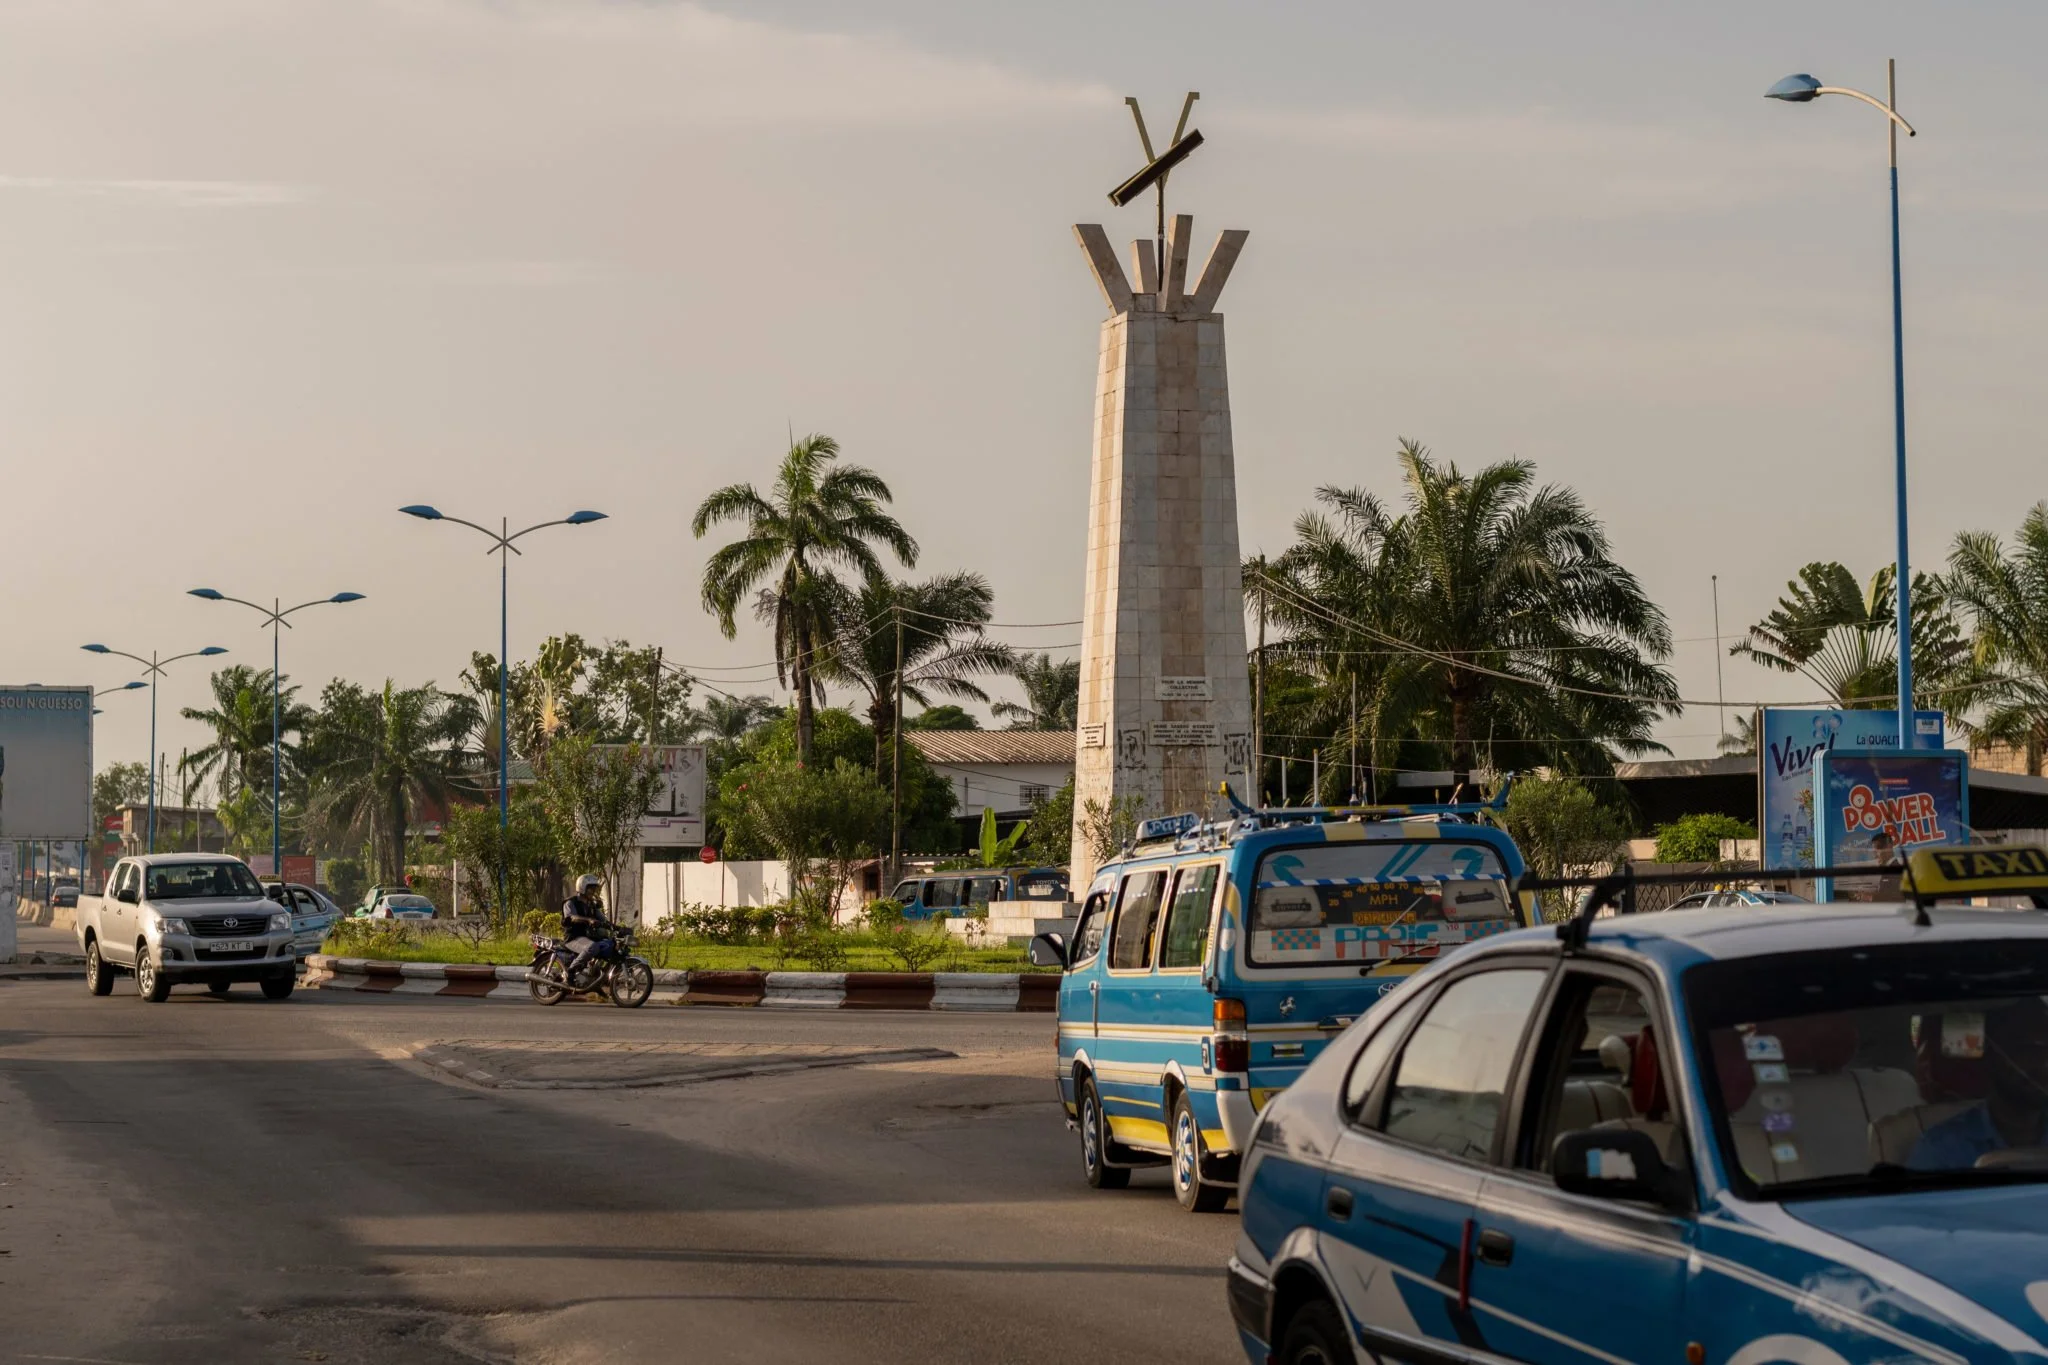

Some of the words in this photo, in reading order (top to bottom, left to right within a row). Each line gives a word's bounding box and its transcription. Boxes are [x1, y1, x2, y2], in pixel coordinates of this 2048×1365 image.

[26, 696, 82, 710] N'GUESSO
[1856, 734, 1866, 745] La
[1843, 785, 1938, 832] POWER
[1884, 816, 1946, 848] BALL
[1939, 851, 2047, 877] TAXI
[1399, 881, 1409, 890] 70
[1369, 893, 1400, 906] MPH
